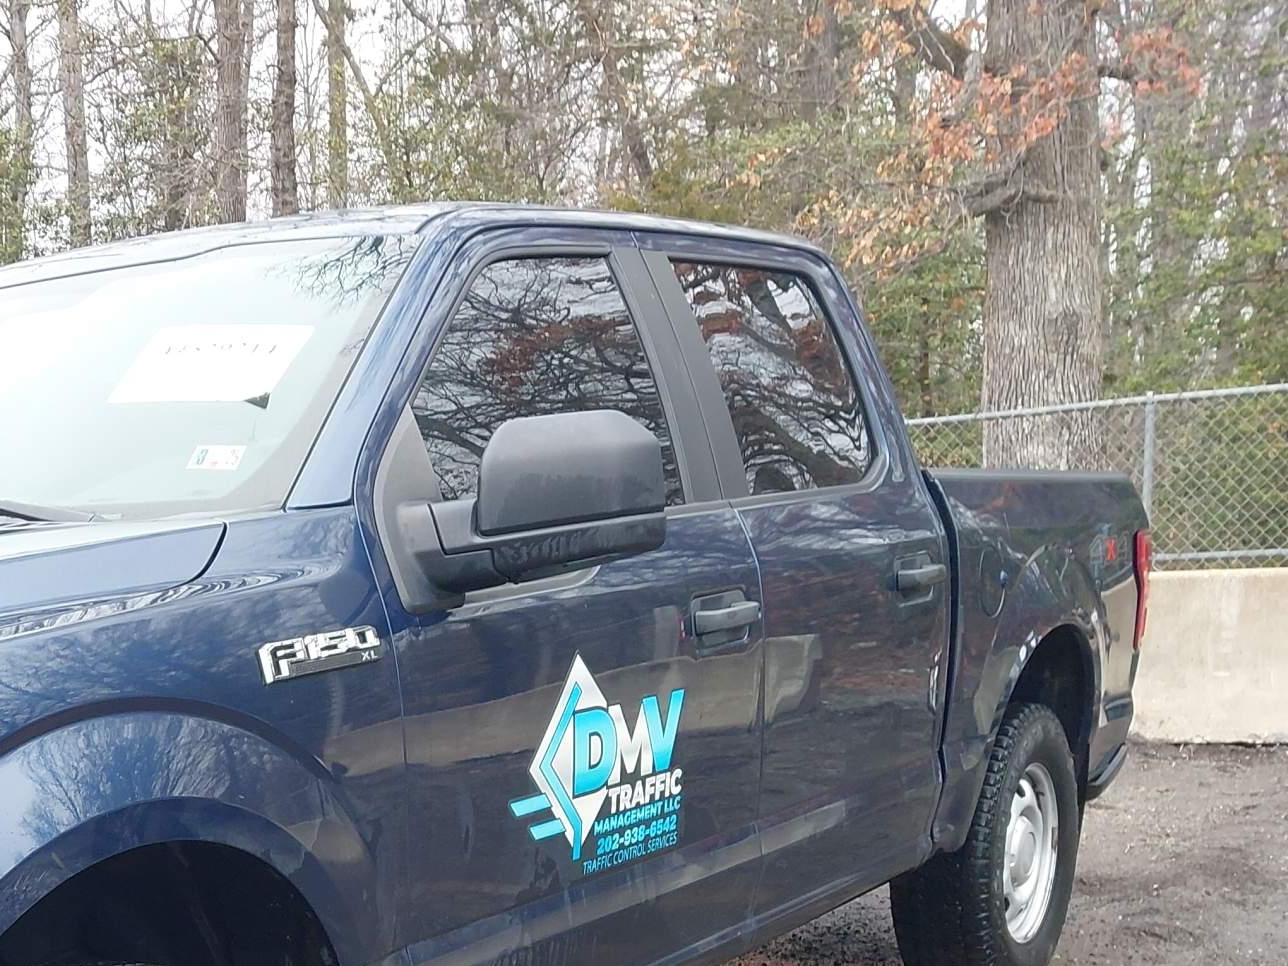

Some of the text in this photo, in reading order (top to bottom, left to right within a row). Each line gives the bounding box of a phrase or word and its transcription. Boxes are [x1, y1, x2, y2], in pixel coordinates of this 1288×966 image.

[361, 650, 379, 661] XL
[573, 688, 685, 798] DMV
[608, 768, 683, 814] TRAFFIC
[594, 796, 681, 836] MANAGEMENT LLC
[597, 814, 677, 855] 202-938-6542
[583, 832, 678, 875] TRAFFIC CONTROL SERVICES
